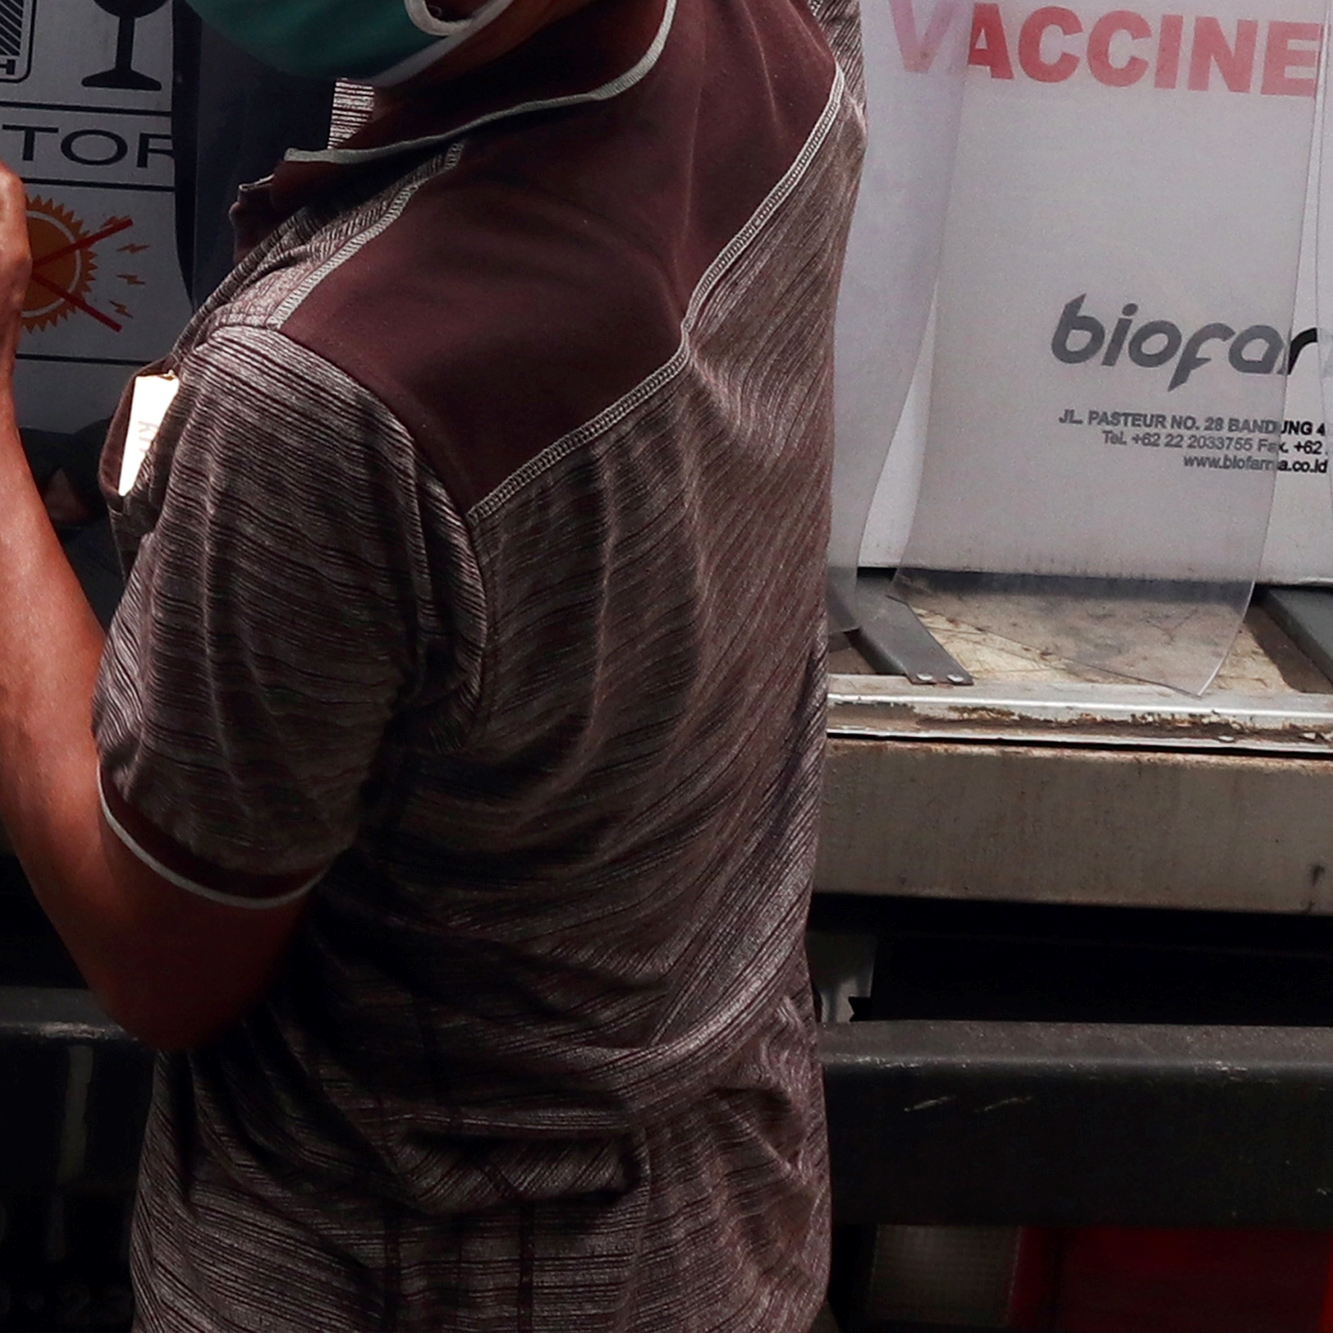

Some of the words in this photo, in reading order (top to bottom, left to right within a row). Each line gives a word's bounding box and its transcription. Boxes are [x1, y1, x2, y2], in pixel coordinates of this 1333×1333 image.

[1087, 410, 1167, 429] PASTEUR
[1171, 416, 1200, 432] NO.
[1203, 416, 1225, 433] 28
[1131, 432, 1161, 448] +62
[1163, 434, 1184, 450] 22
[1187, 435, 1254, 452] 2033755
